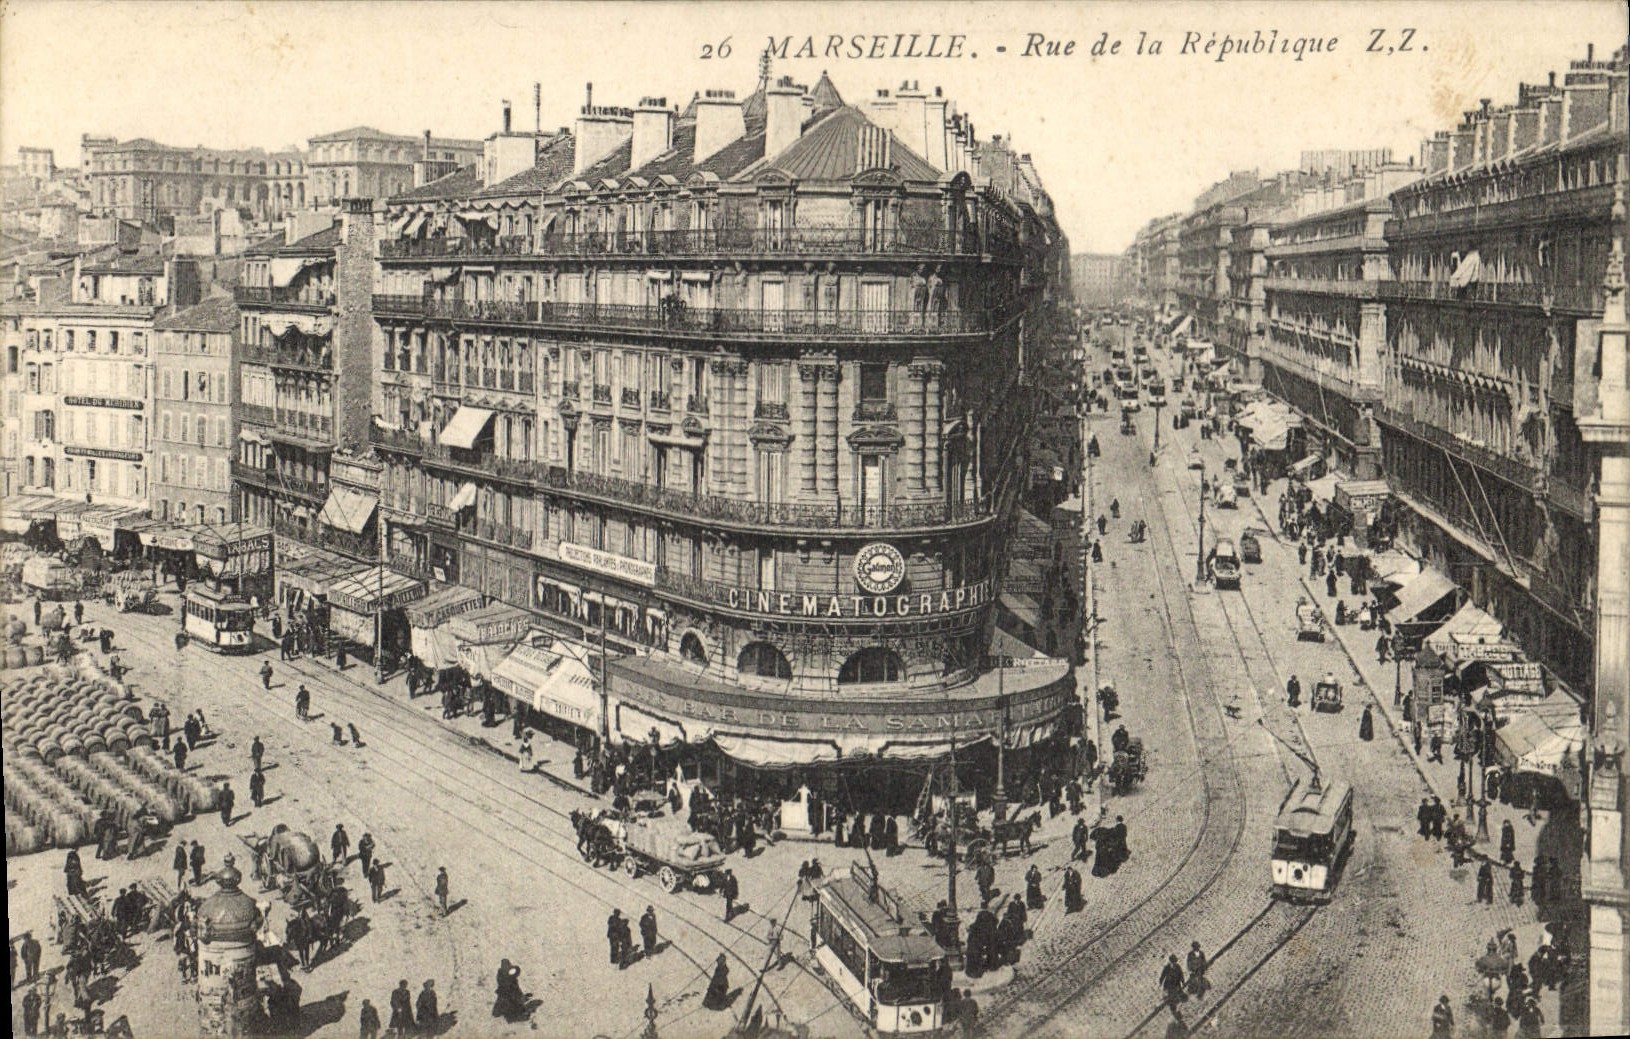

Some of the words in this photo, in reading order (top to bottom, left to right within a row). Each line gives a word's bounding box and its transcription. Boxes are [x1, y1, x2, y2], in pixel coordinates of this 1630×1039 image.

[227, 536, 270, 554] TABACS
[863, 562, 899, 575] Gaumont
[436, 596, 483, 620] CASQUETTES
[683, 700, 741, 723] BAR
[757, 711, 800, 728] DE
[820, 716, 867, 730] LA
